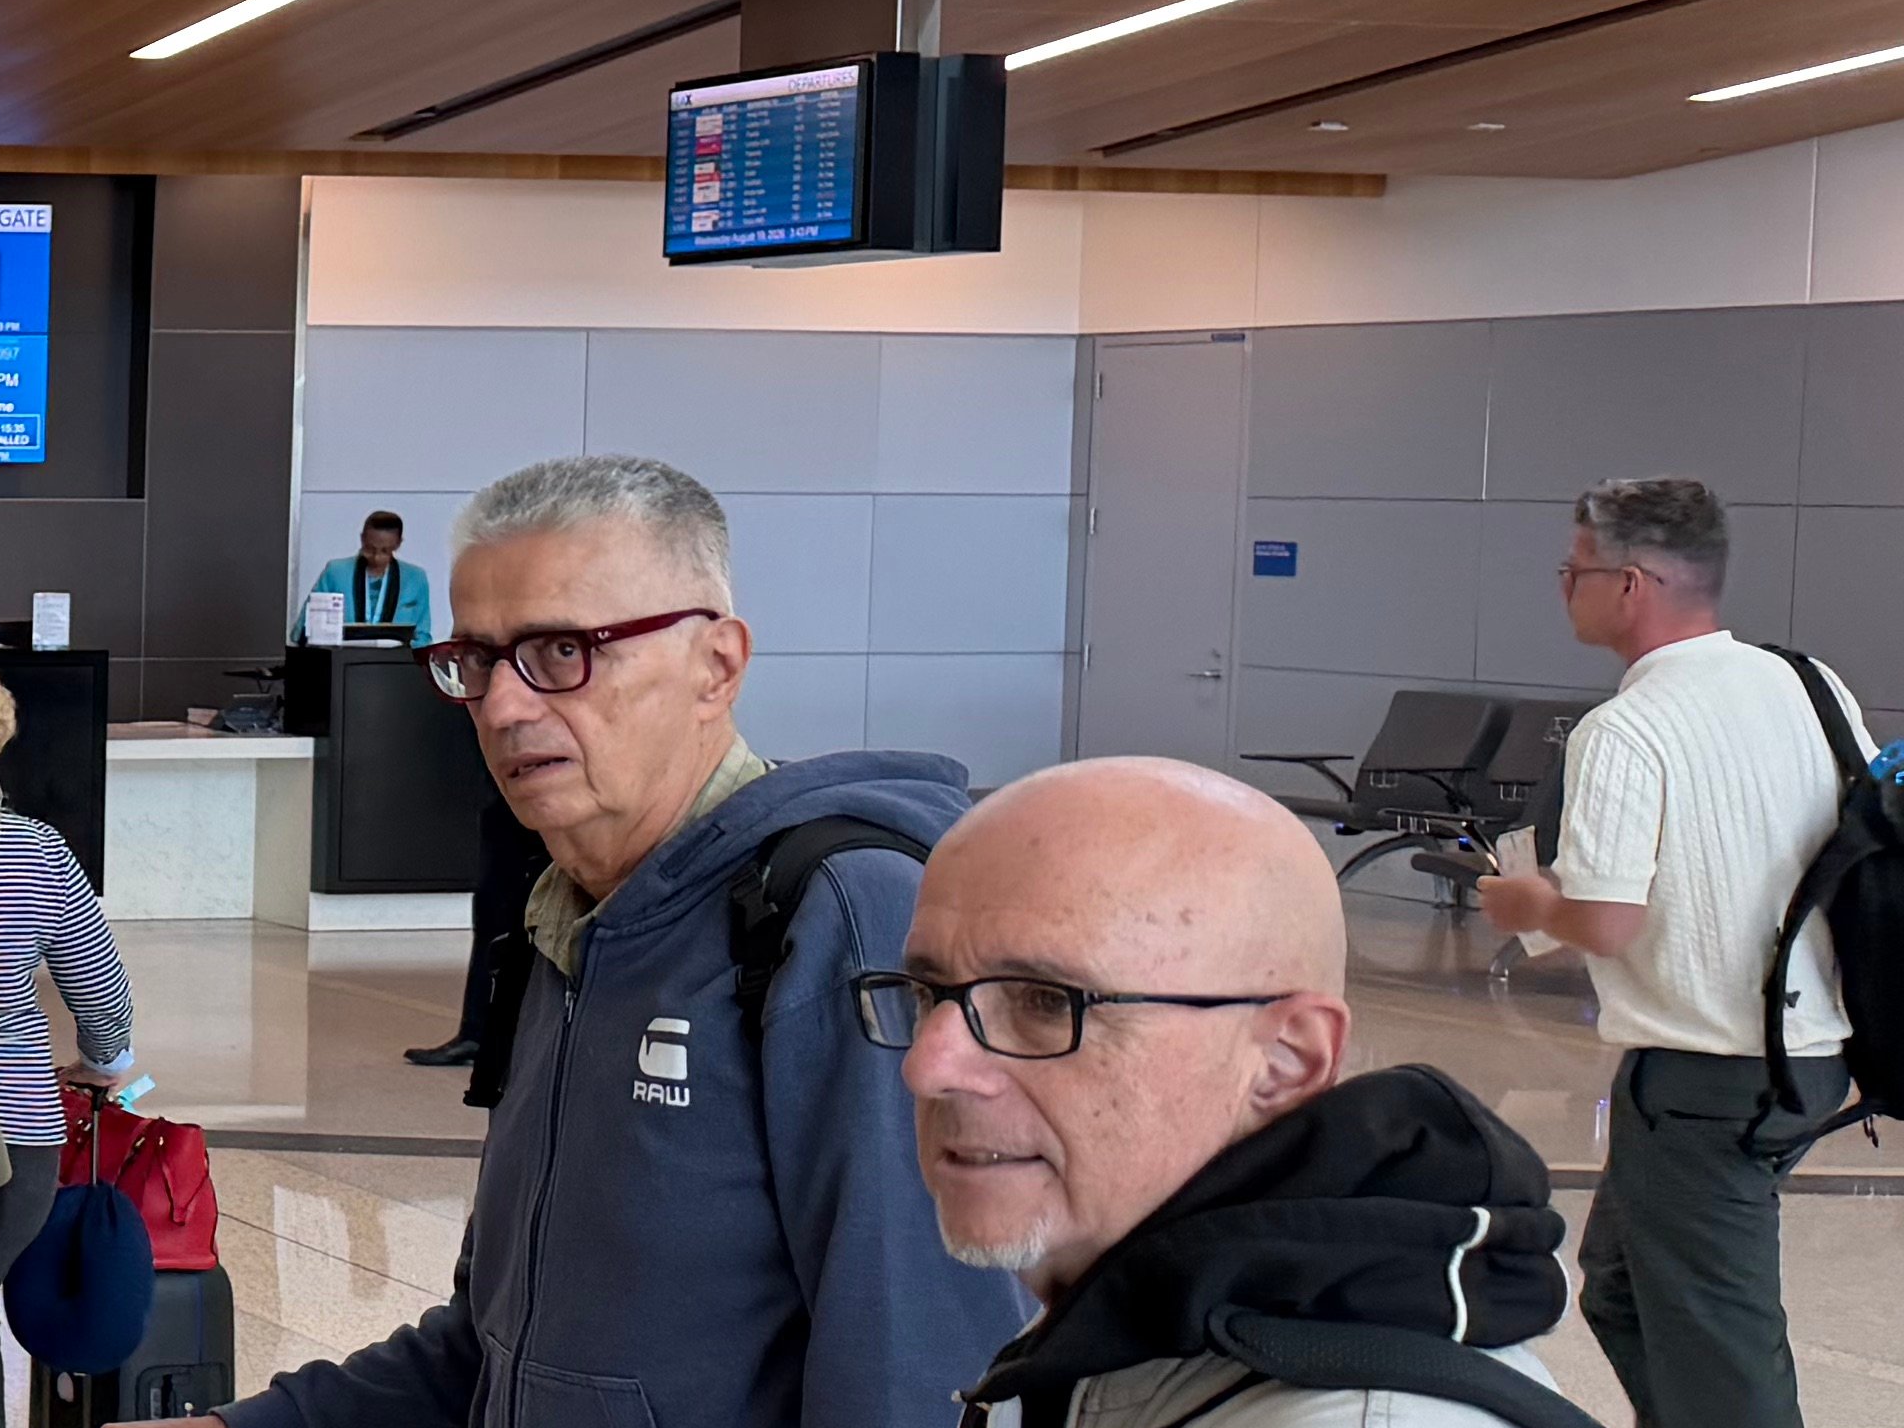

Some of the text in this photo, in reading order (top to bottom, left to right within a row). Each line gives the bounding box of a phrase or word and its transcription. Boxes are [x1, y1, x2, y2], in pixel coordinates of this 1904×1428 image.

[787, 72, 855, 93] DEPARTURES
[5, 322, 21, 332] PM
[632, 1080, 691, 1108] RAW
